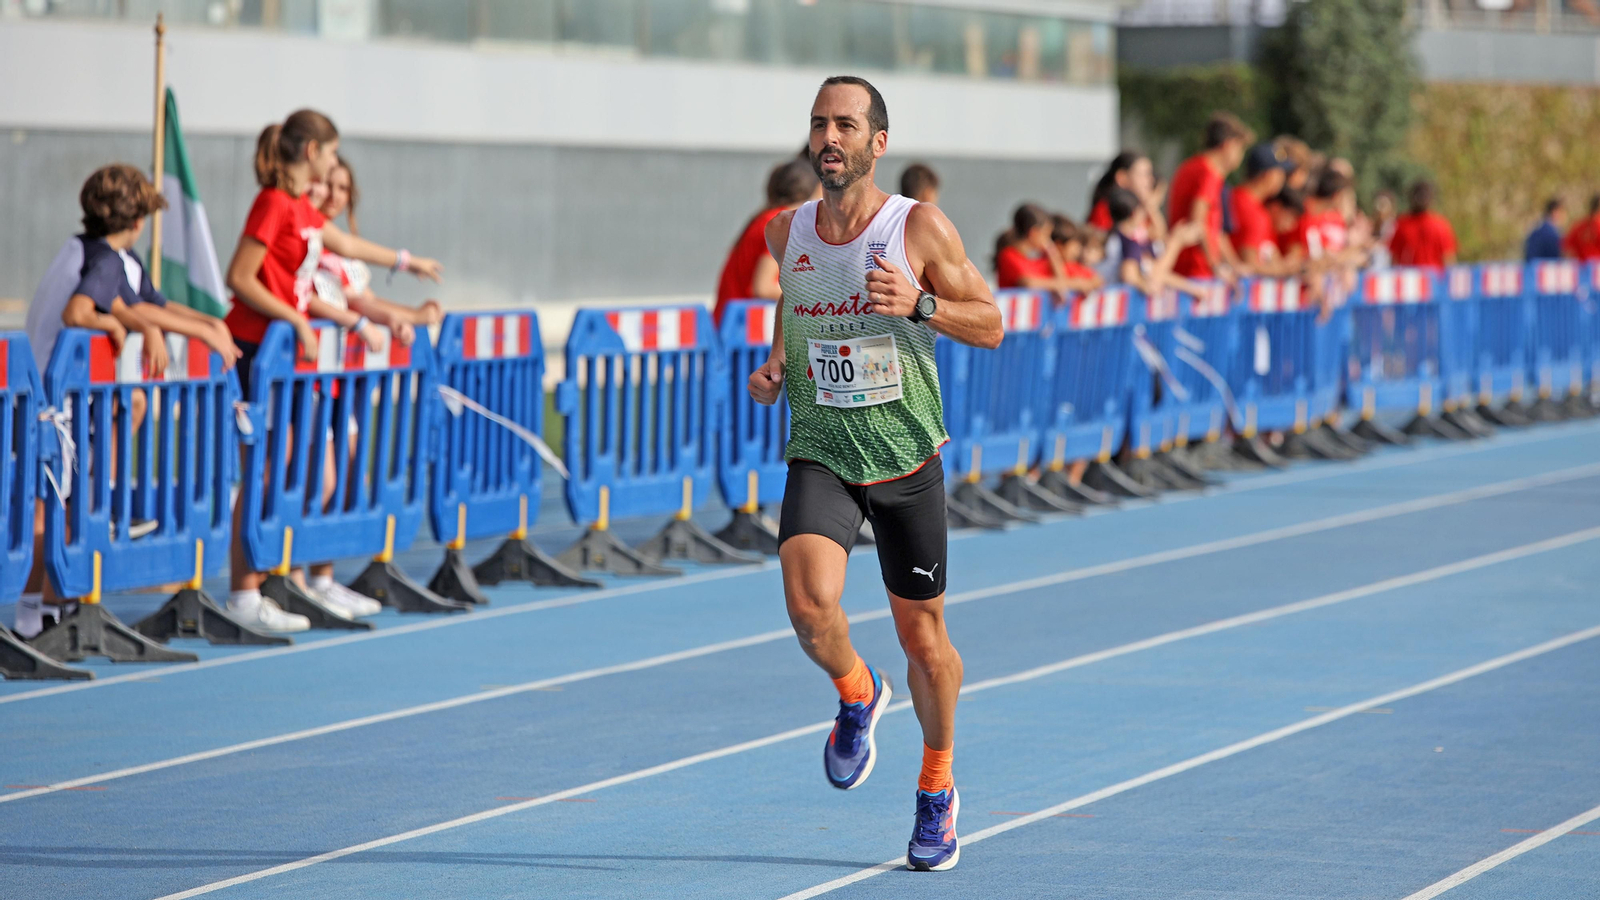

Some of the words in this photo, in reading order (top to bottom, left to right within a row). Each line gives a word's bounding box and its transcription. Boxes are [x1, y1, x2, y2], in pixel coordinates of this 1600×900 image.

[794, 292, 874, 317] marato
[820, 322, 866, 333] JEREZ
[816, 358, 855, 383] 700
